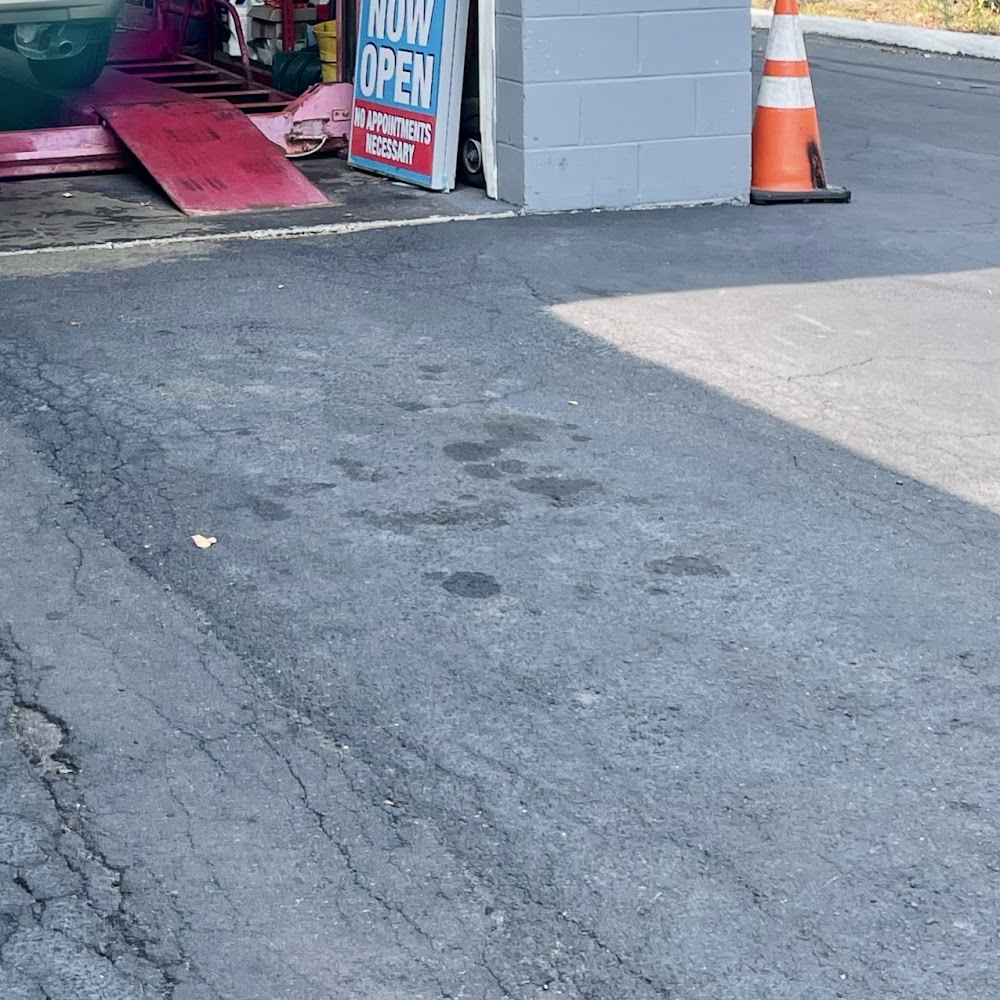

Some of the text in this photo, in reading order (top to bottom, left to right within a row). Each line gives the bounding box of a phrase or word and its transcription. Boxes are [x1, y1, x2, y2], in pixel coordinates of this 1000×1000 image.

[360, 42, 434, 109] OPEN
[354, 106, 432, 146] NO APPOINTMENTS
[365, 132, 415, 166] NECESSARY
